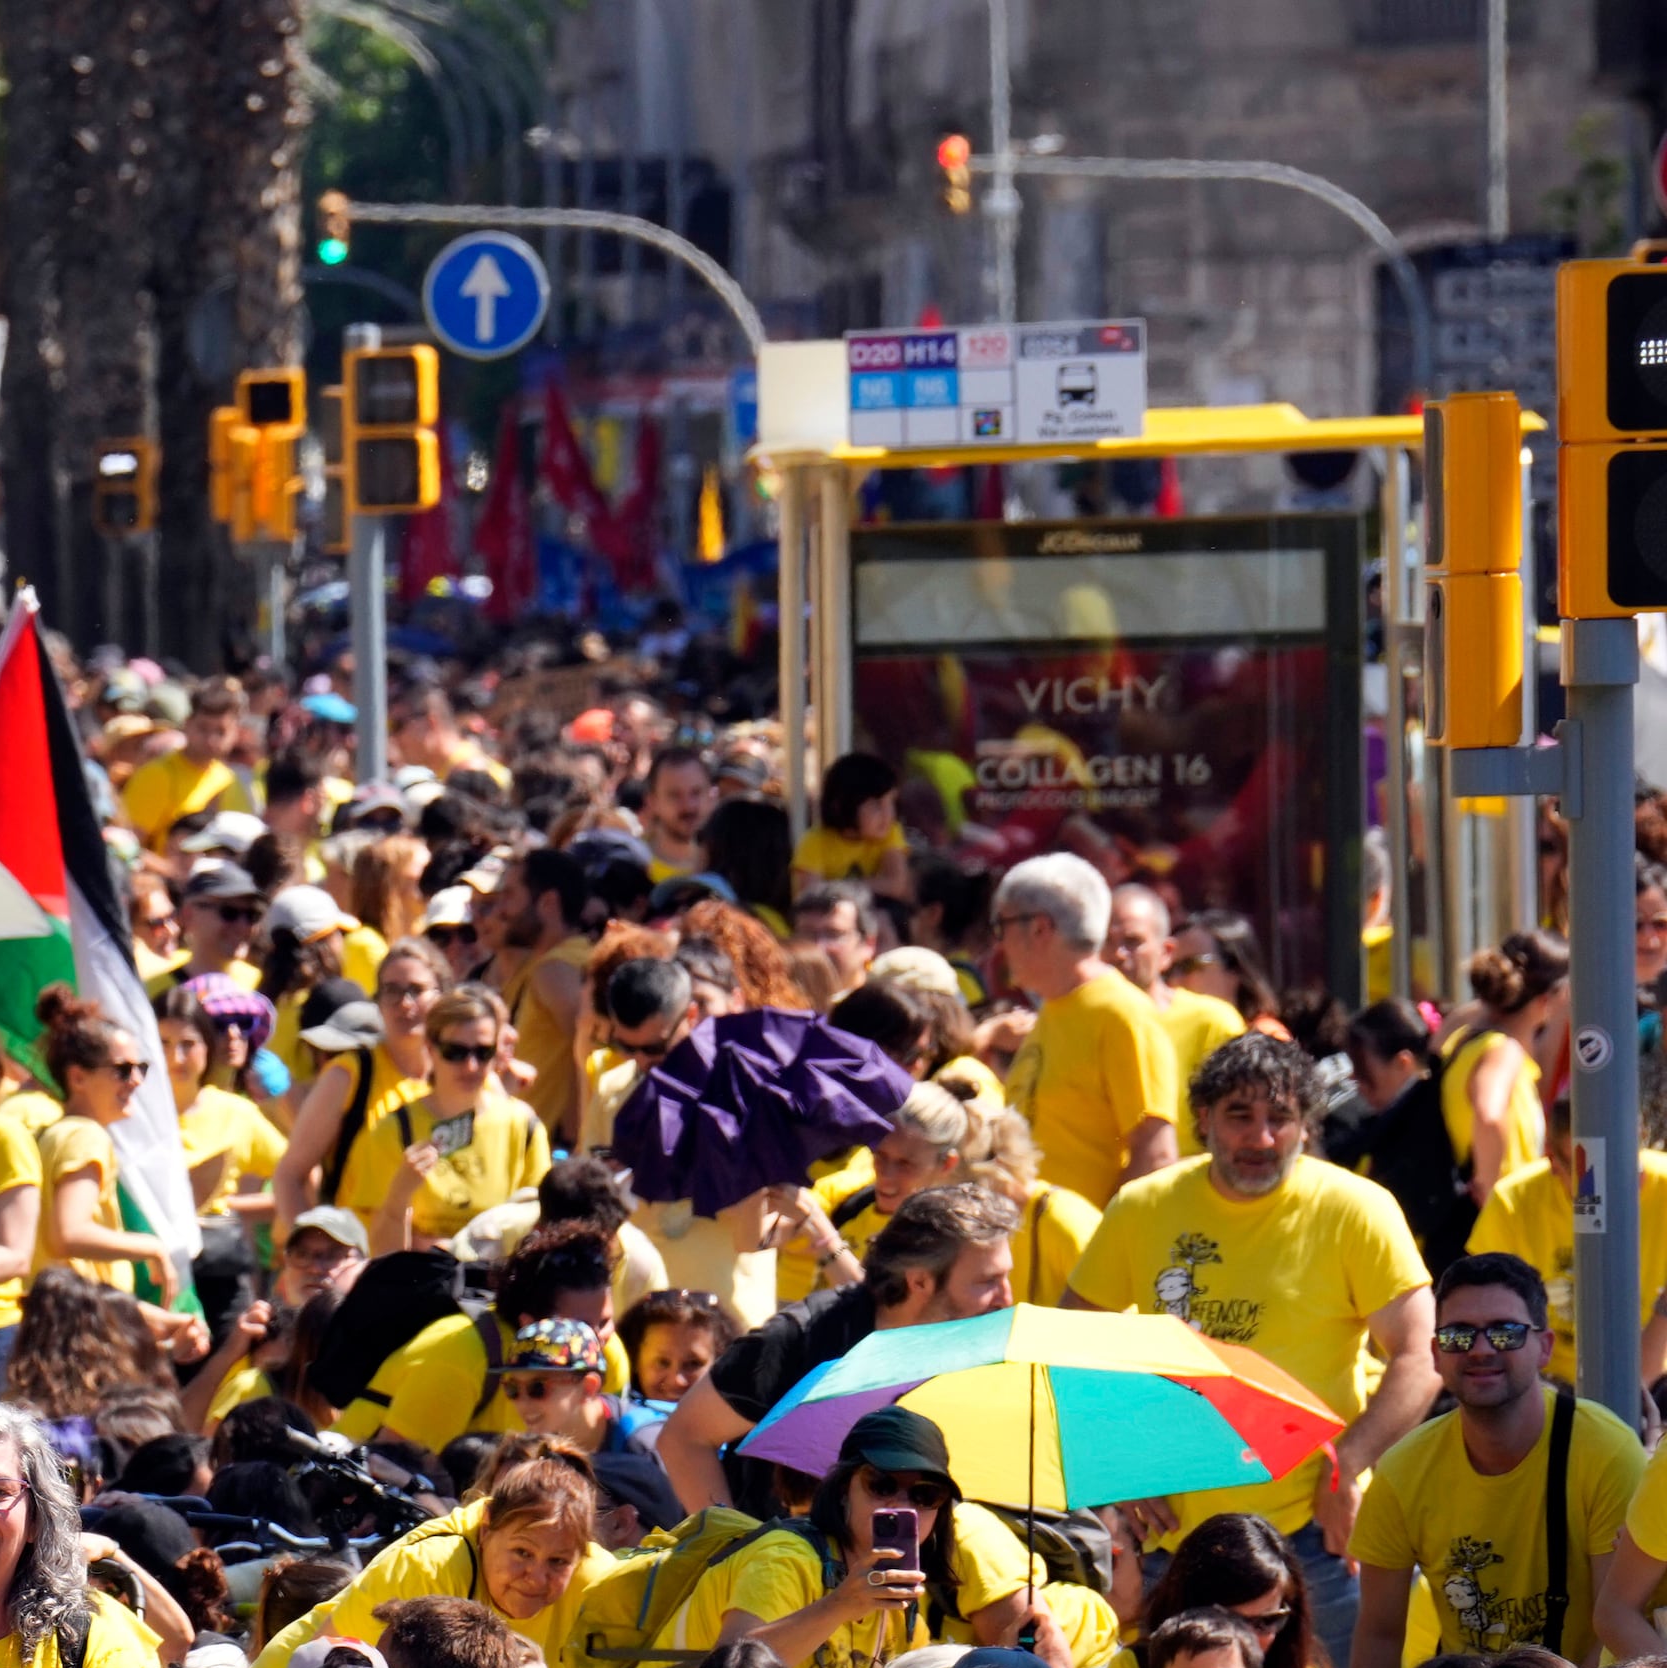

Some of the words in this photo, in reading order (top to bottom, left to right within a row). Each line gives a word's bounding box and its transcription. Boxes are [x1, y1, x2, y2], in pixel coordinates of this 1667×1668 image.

[851, 341, 901, 364] D20
[904, 337, 955, 361] H14
[1016, 674, 1167, 714] VICHY
[975, 753, 1163, 789] COLLAGEN
[1171, 752, 1213, 785] 16
